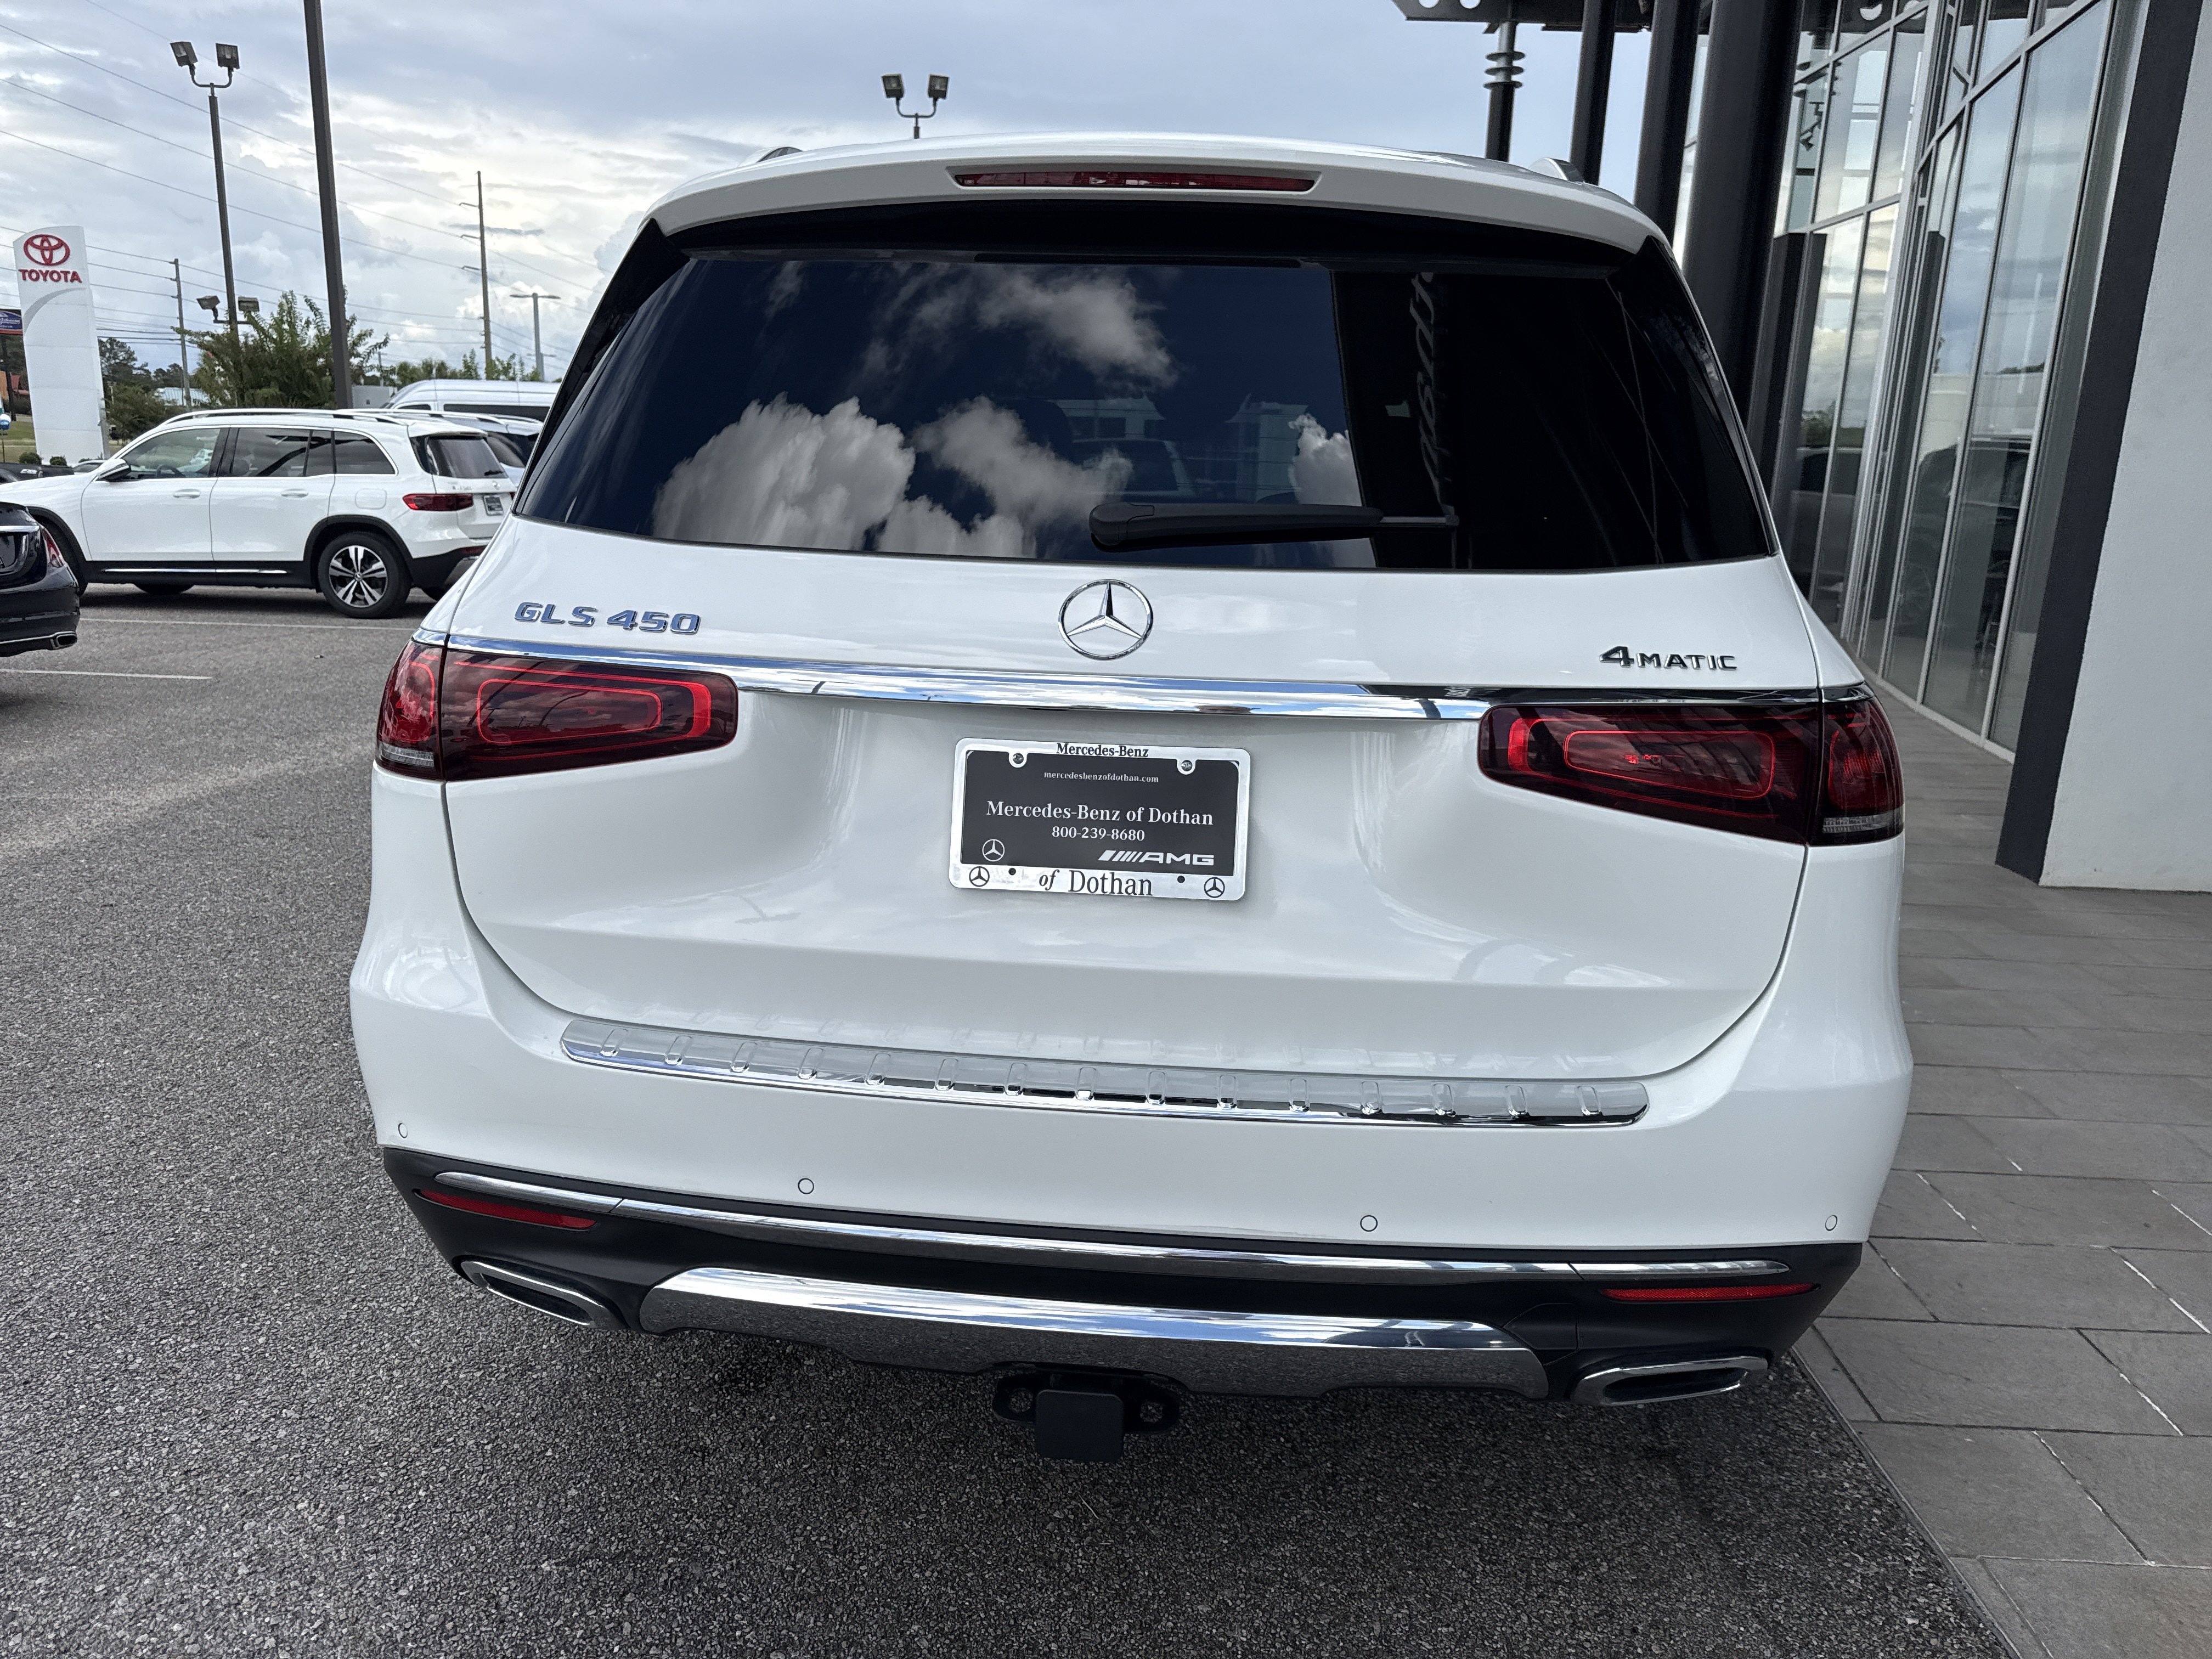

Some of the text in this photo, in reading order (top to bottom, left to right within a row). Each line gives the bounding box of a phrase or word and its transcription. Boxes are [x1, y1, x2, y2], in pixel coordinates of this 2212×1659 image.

[18, 269, 82, 283] TOYOTA
[514, 602, 701, 635] GLS 450
[1599, 646, 1737, 670] 4MATIC
[1056, 743, 1149, 757] Mercedes-Benz
[1043, 771, 1159, 783] mercedesbenzofdothan.com
[986, 800, 1213, 825] Mercedes-Benz of Dothan
[1052, 826, 1146, 841] 800-239-8680
[1142, 853, 1214, 865] AMG
[1039, 870, 1152, 896] of Dothan
